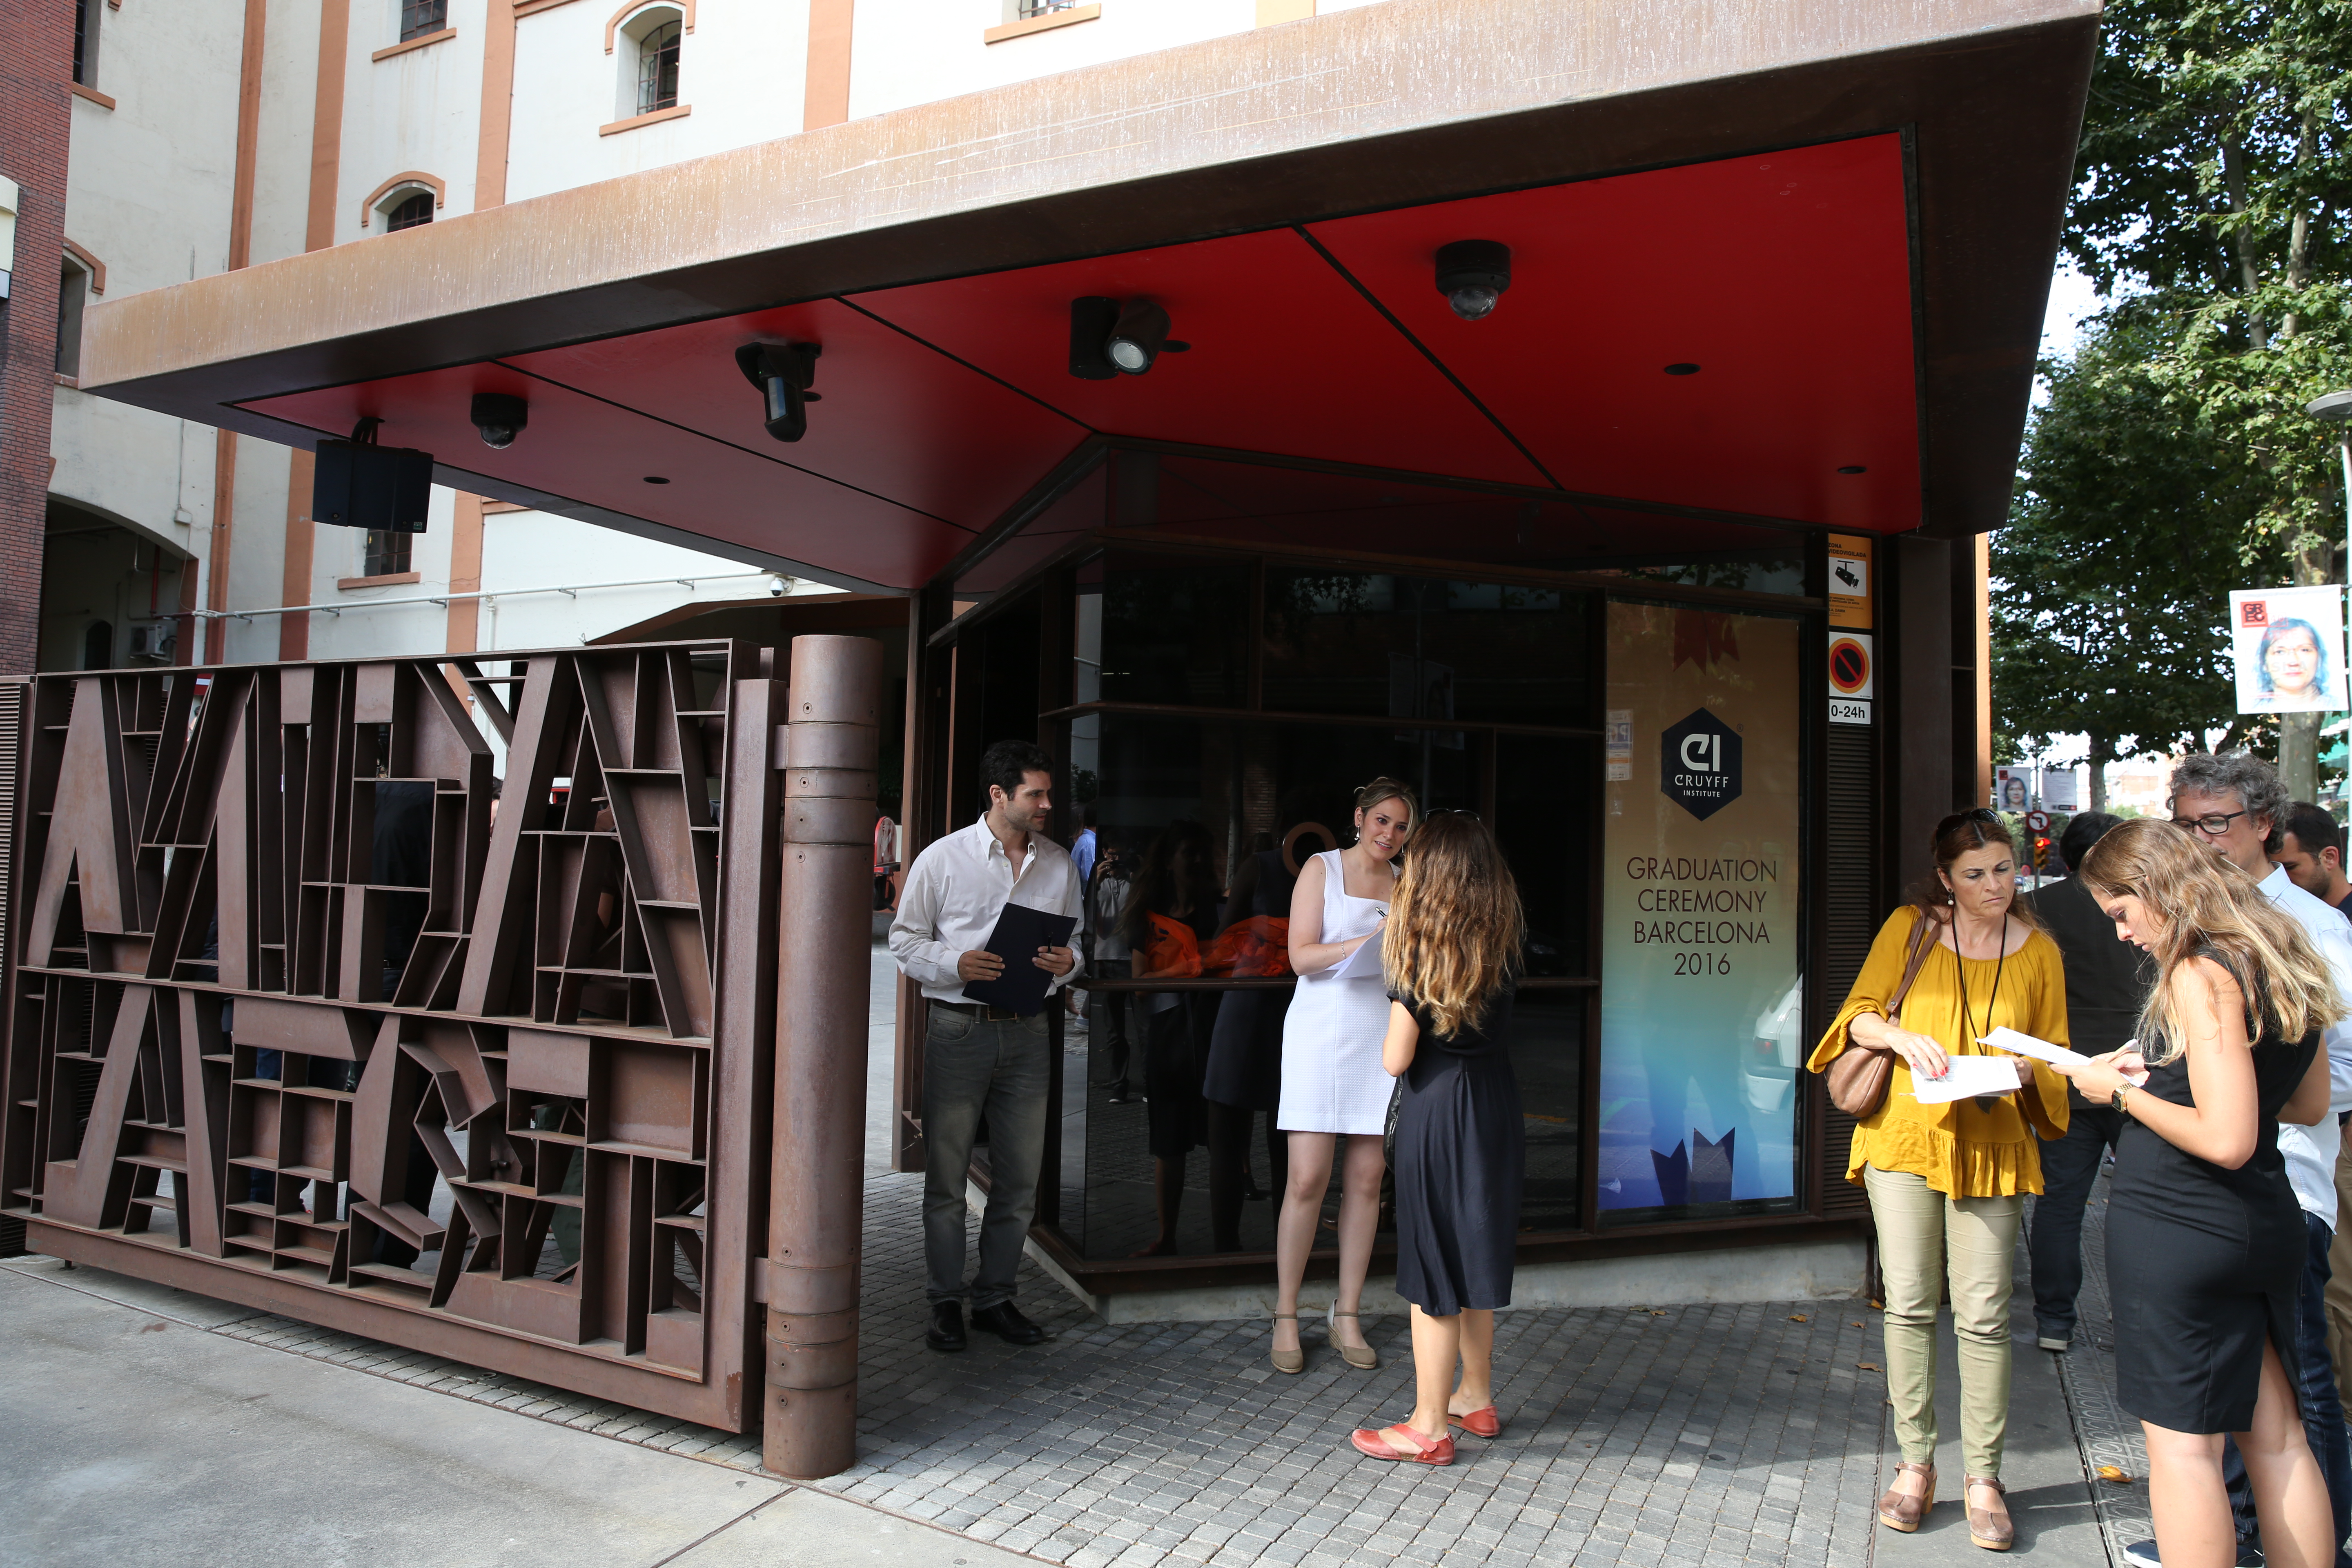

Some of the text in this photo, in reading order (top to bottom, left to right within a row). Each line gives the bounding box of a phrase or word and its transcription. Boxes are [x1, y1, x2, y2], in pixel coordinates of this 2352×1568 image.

[1829, 549, 1866, 557] VIDEOVIGILADA
[1831, 704, 1865, 719] 0-24h
[1675, 774, 1729, 788] CRUYFF
[1626, 856, 1777, 882] GRADUATION
[1637, 889, 1767, 913] CEREMONY
[1634, 920, 1771, 944] BARCELONA
[1674, 952, 1731, 975] 2016
